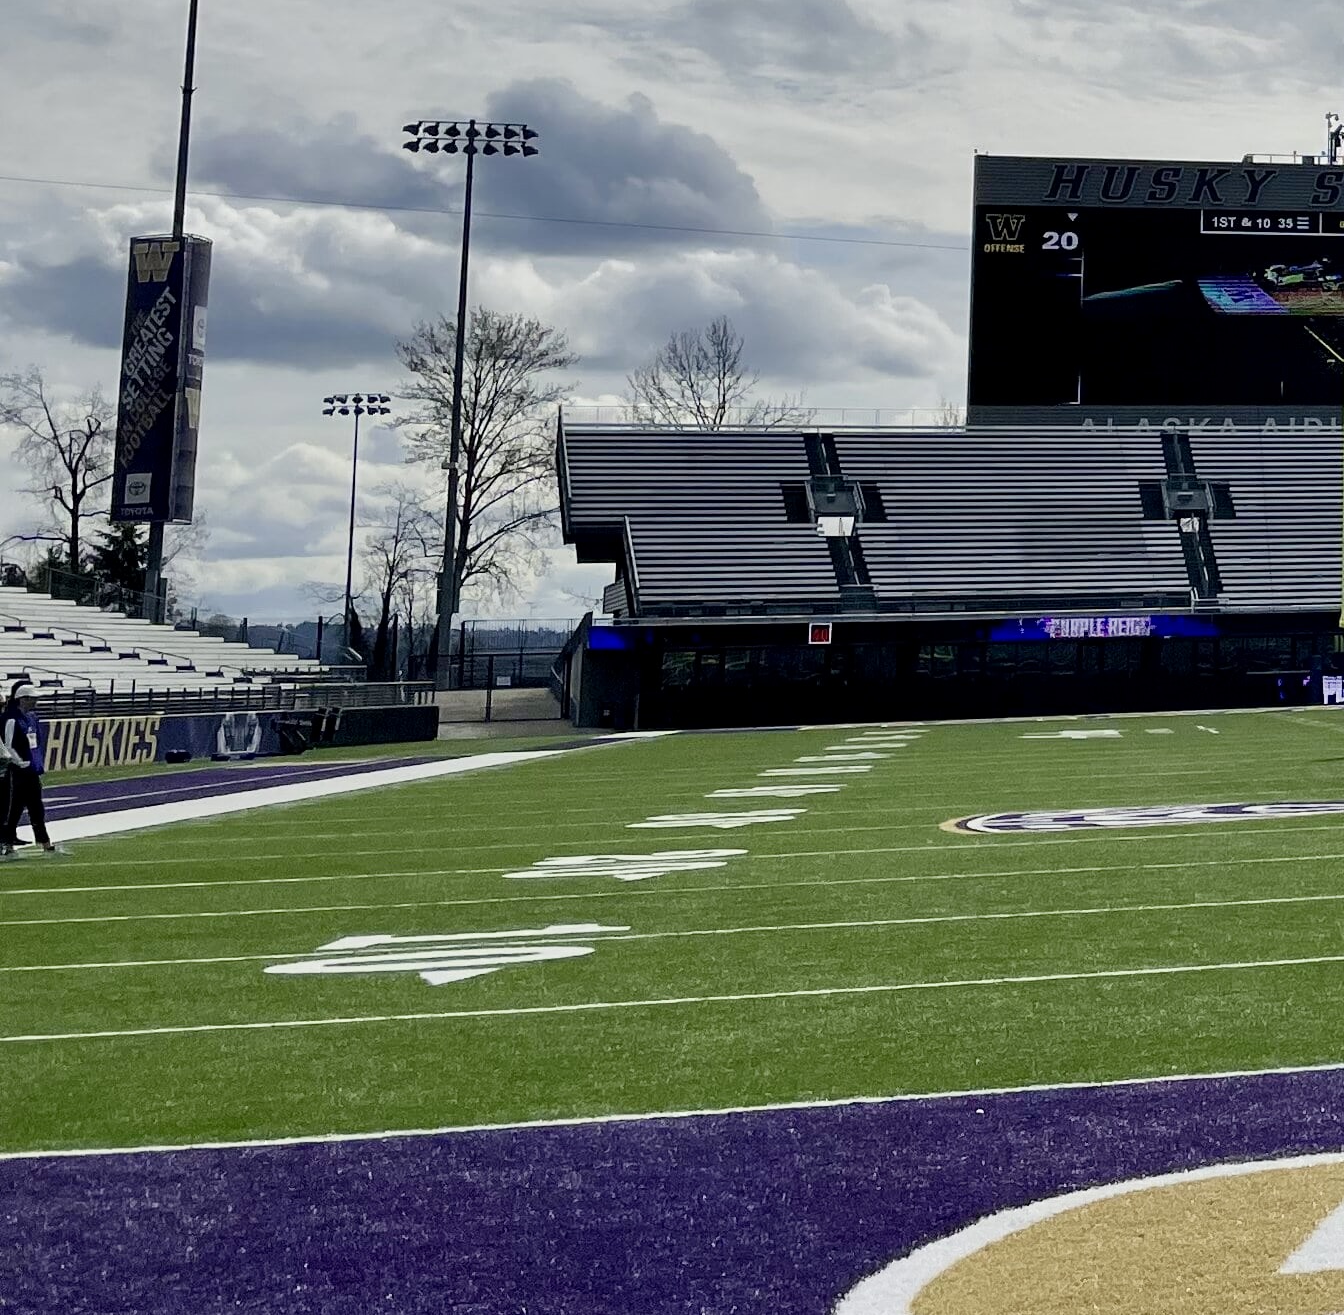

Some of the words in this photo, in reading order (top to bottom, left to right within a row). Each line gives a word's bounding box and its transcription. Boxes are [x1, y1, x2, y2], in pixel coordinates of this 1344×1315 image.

[1043, 164, 1277, 205] HUSKY
[1042, 232, 1078, 250] 20
[1212, 217, 1236, 228] 1ST
[1257, 219, 1270, 228] 10
[1278, 219, 1293, 228] 35
[984, 243, 1025, 253] OFFENSE
[124, 286, 177, 377] GREATEST
[122, 327, 174, 411] SETTING
[44, 717, 161, 771] HUSKIES
